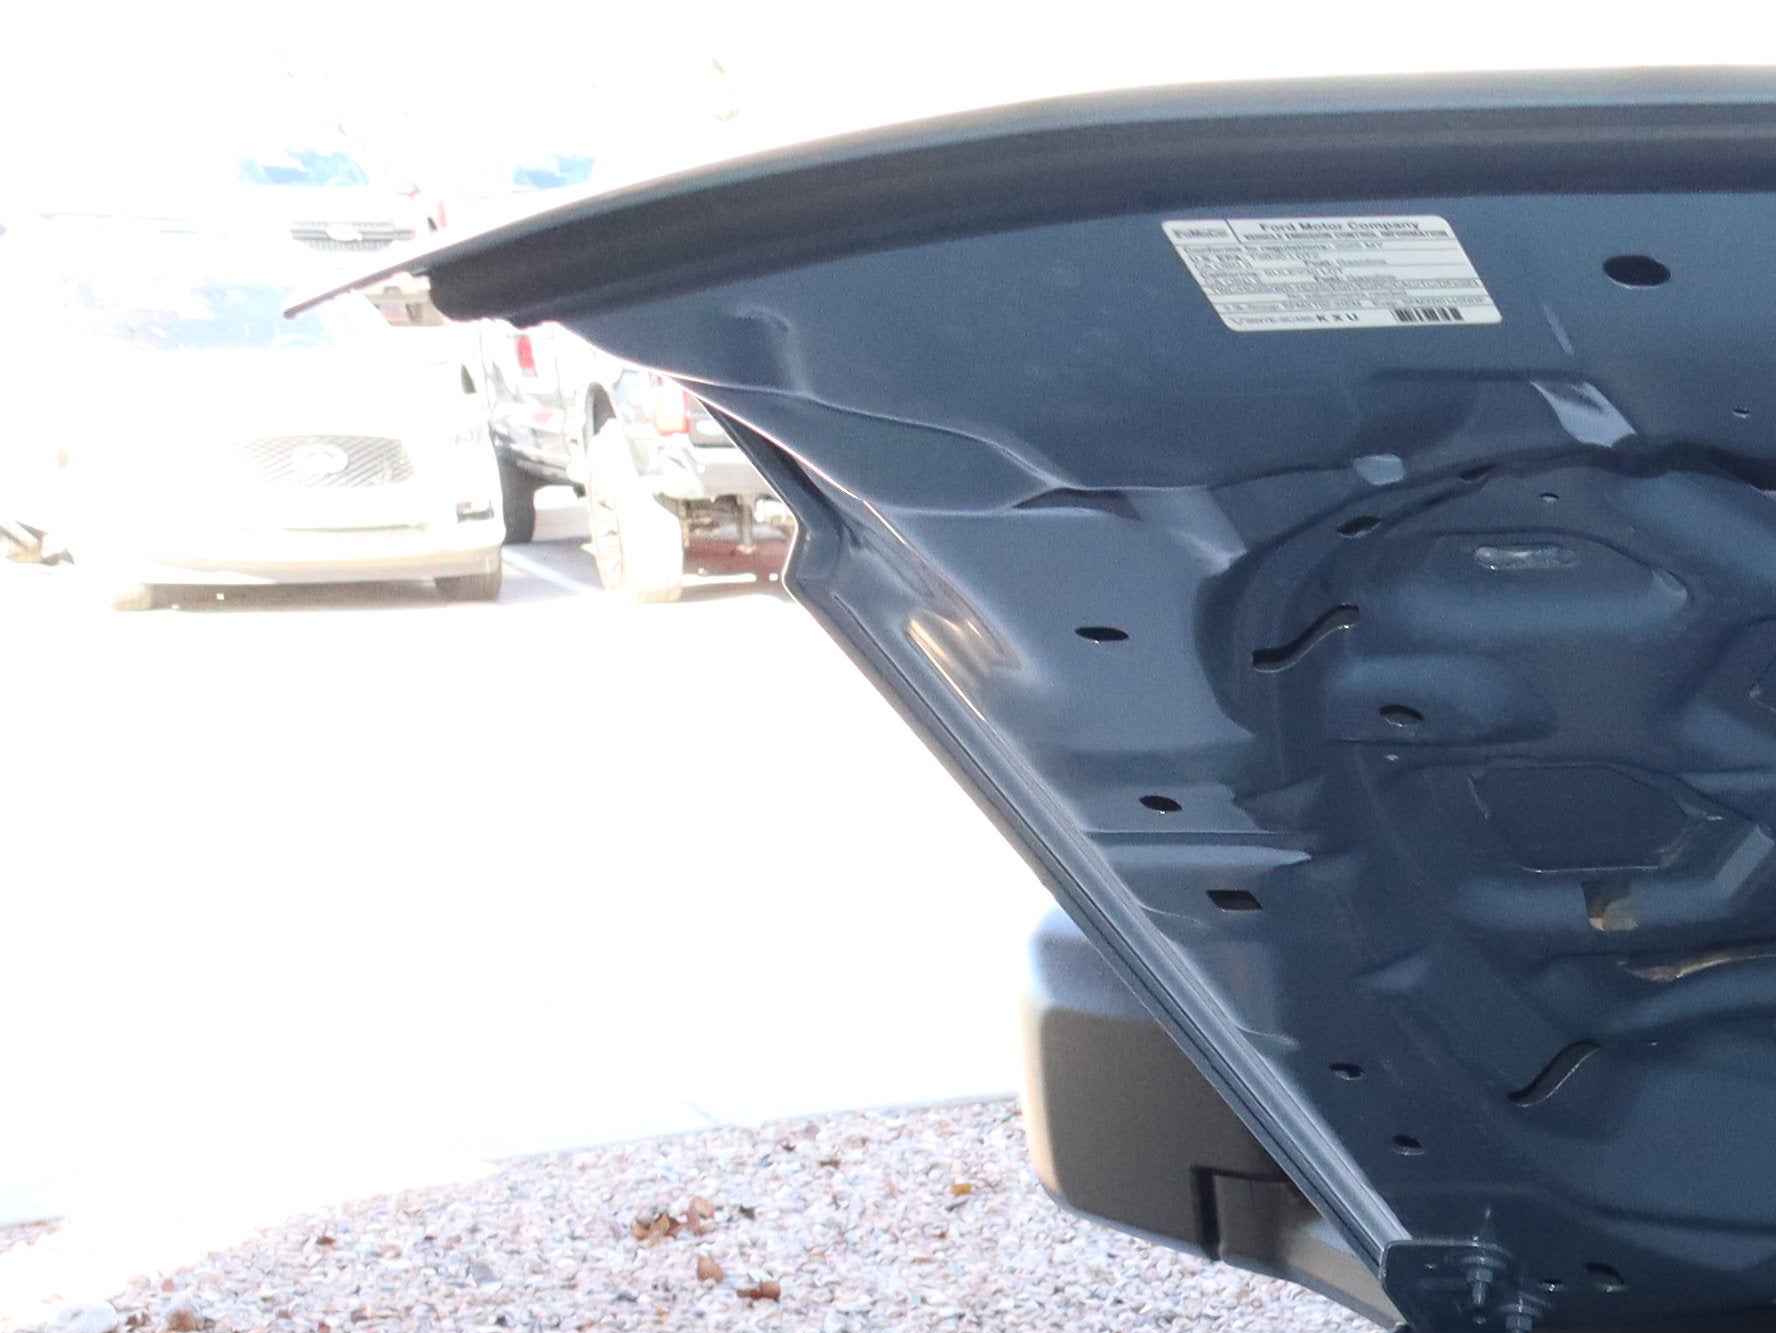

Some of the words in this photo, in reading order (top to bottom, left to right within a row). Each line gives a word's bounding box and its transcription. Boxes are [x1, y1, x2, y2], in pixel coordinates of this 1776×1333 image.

[1258, 223, 1296, 231] Ford
[1298, 221, 1345, 230] Motor
[1345, 219, 1421, 231] Company
[1380, 229, 1448, 238] INFORMATION
[1331, 313, 1343, 321] X
